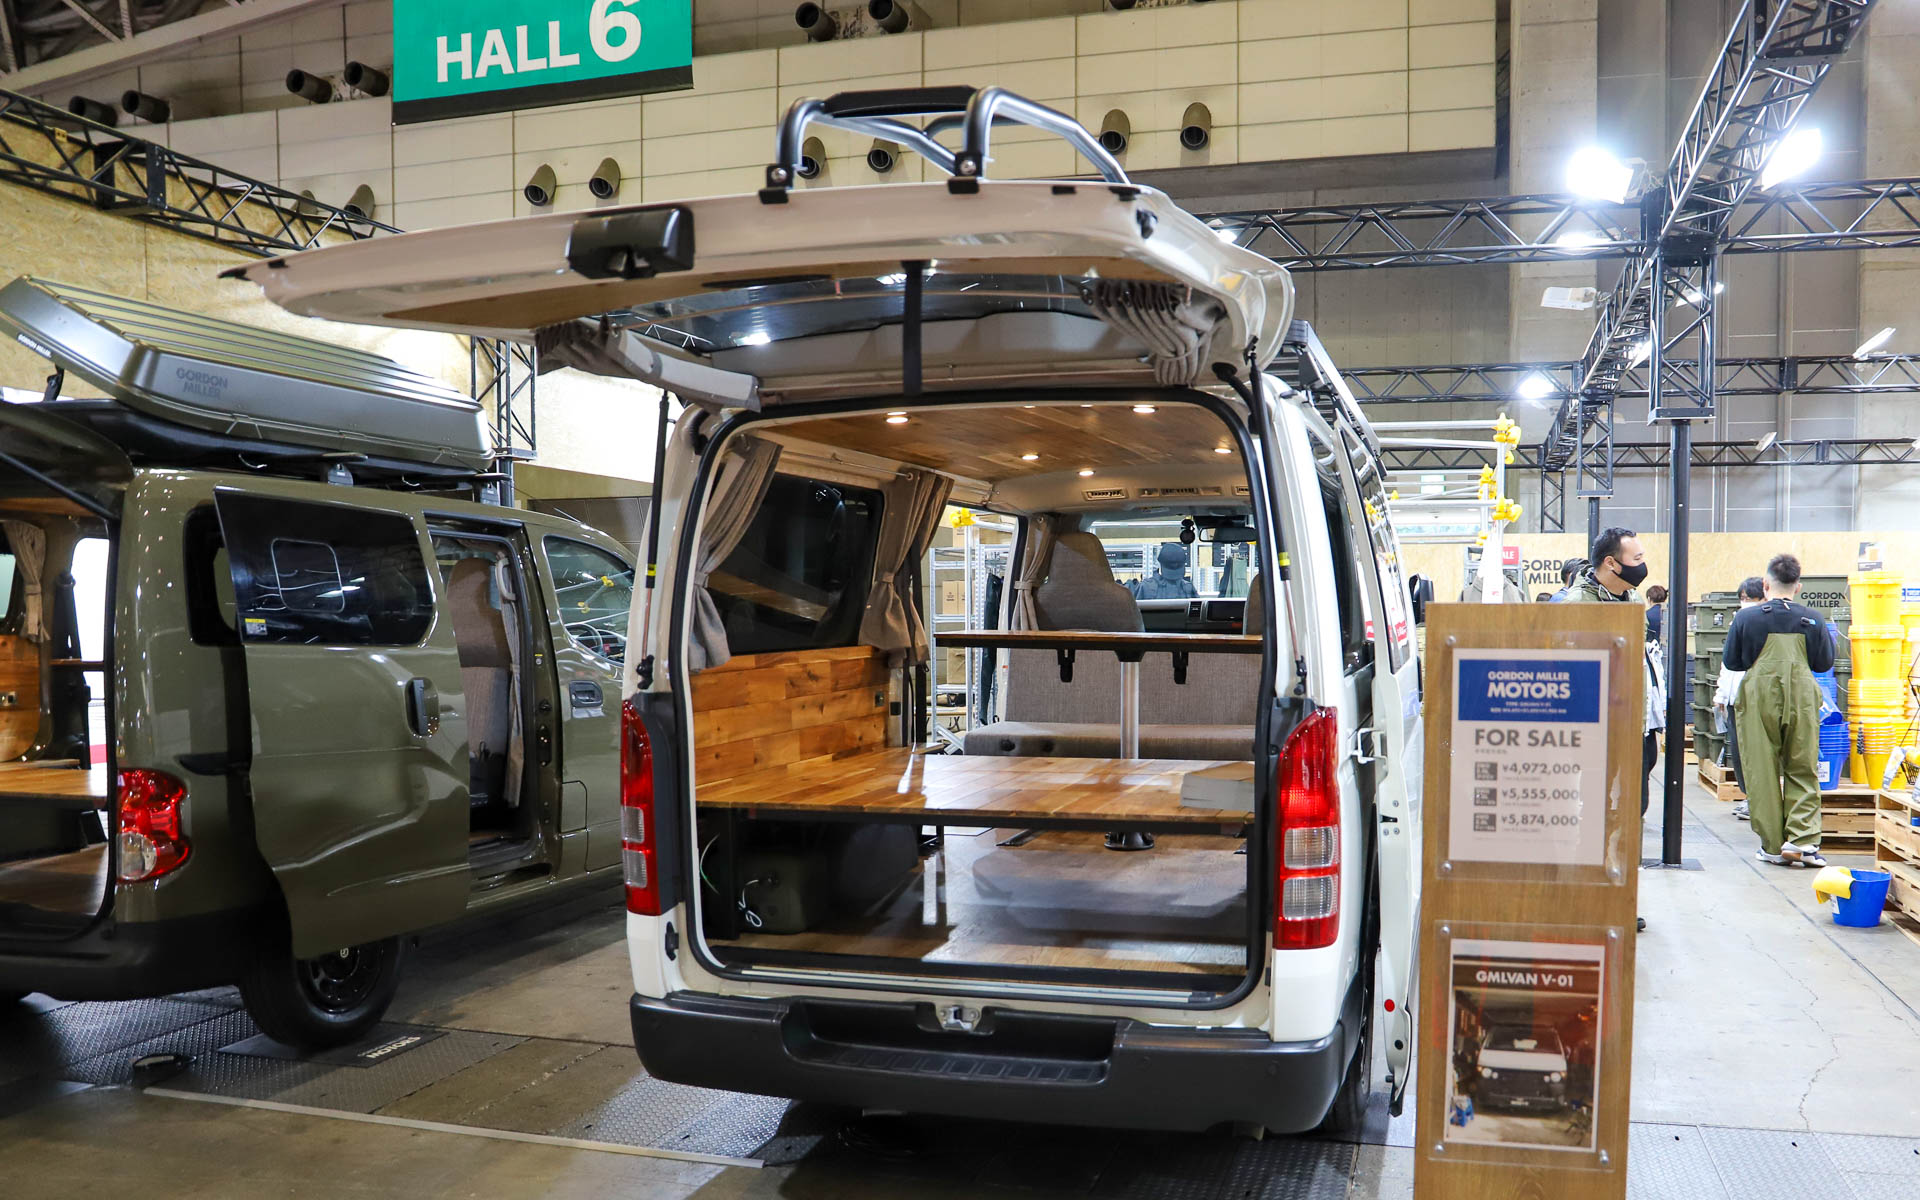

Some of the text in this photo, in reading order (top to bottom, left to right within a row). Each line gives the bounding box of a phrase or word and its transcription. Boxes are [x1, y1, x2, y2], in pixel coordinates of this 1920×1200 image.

[436, 0, 642, 83] HALL 6
[176, 367, 229, 388] GORDON
[183, 381, 221, 399] MILLER
[1522, 560, 1563, 571] GORD
[1528, 573, 1561, 584] MILL
[1807, 600, 1840, 608] MILLER
[1487, 671, 1570, 681] GORDON MILLER
[1487, 682, 1571, 699] MOTORS
[1475, 729, 1581, 747] FOR SALE
[1502, 762, 1581, 775] ¥4,972,000
[1502, 788, 1579, 801] ¥5,555,000
[1501, 814, 1578, 827] ¥5,874,000
[1476, 971, 1574, 987] GMLVAN V-01
